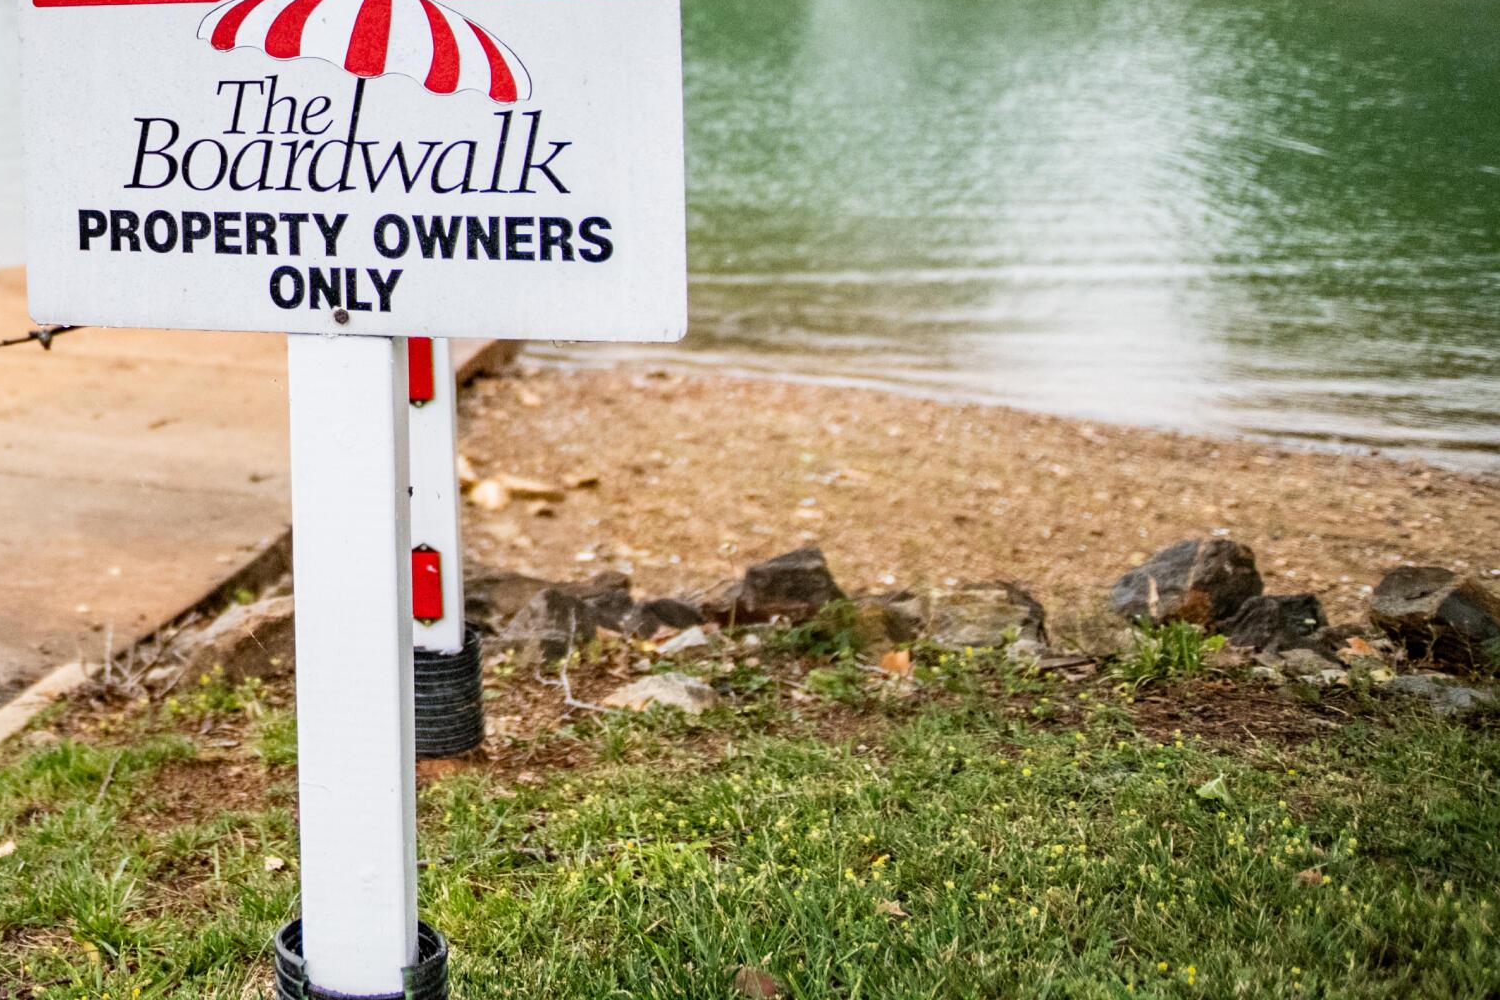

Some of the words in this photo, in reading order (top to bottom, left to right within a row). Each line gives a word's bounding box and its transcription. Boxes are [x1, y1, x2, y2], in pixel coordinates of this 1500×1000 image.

[216, 75, 333, 136] The
[124, 108, 573, 195] Boardwalk
[78, 208, 349, 256] PROPERTY
[373, 213, 614, 263] OWNERS
[269, 266, 404, 313] ONLY
